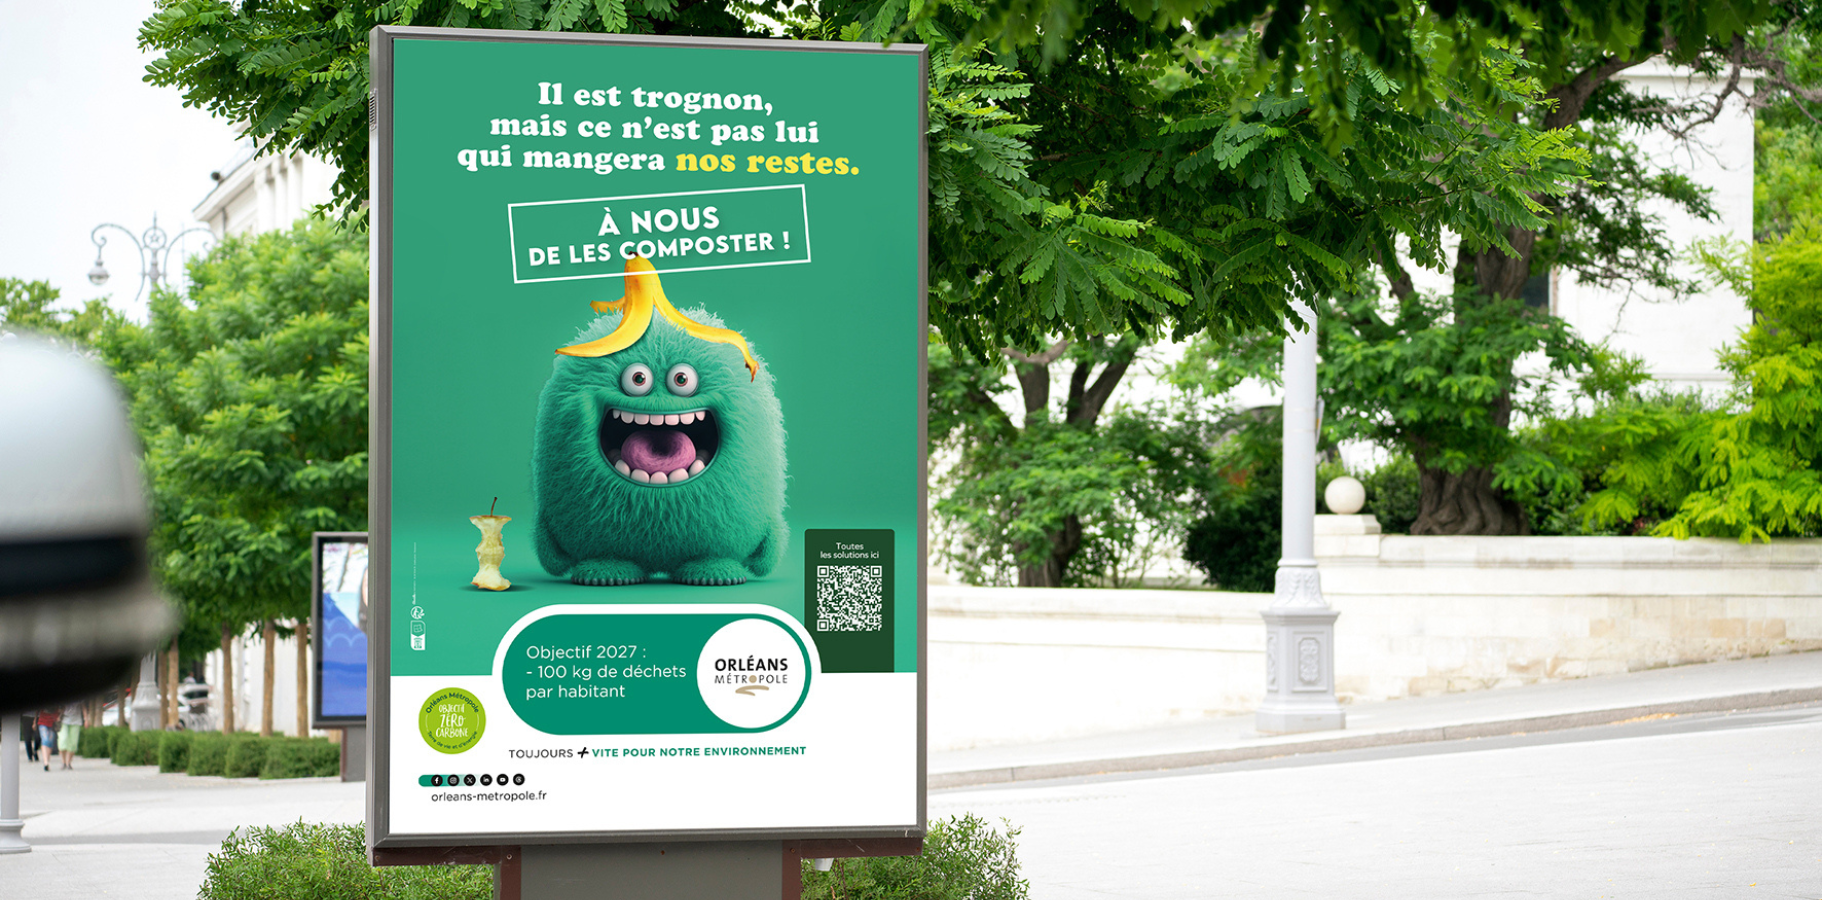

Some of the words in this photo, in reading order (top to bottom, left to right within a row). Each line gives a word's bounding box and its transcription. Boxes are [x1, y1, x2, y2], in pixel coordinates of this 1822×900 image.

[538, 82, 563, 105] Il
[574, 86, 622, 107] est
[631, 87, 773, 116] trognon,
[490, 114, 567, 137] mais
[577, 120, 611, 138] ce
[710, 123, 765, 146] pas
[775, 121, 820, 143] lui
[457, 144, 513, 172] qui
[522, 149, 666, 175] mangera
[676, 154, 736, 172] nos
[747, 152, 860, 175] restes.
[597, 207, 621, 236] À
[631, 206, 720, 235] NOUS
[529, 246, 561, 267] DE
[569, 242, 612, 264] LES
[618, 233, 775, 261] COMPOSTER
[783, 231, 791, 250] !
[836, 542, 864, 550] Toutes
[820, 550, 832, 559] les
[833, 550, 869, 559] solutions
[870, 550, 879, 559] ici
[526, 645, 592, 661] Objectif
[596, 645, 637, 659] 2027
[714, 655, 788, 672] ORLÉANS
[537, 665, 567, 679] 100
[573, 665, 592, 680] kg
[597, 665, 618, 678] de
[623, 664, 687, 678] déchets
[714, 673, 788, 684] MÉTROPOLE
[526, 686, 553, 701] par
[558, 685, 626, 698] habitant
[425, 694, 448, 714] Orléans
[449, 692, 479, 713] Métropole
[435, 727, 468, 739] CARBONE
[509, 749, 574, 759] TOUJOURS
[592, 748, 619, 757] VITE
[623, 748, 656, 757] POUR
[660, 747, 700, 757] NOTRE
[704, 746, 807, 757] ENVIRONNEMENT
[431, 790, 547, 802] orleans-metropole.fr
